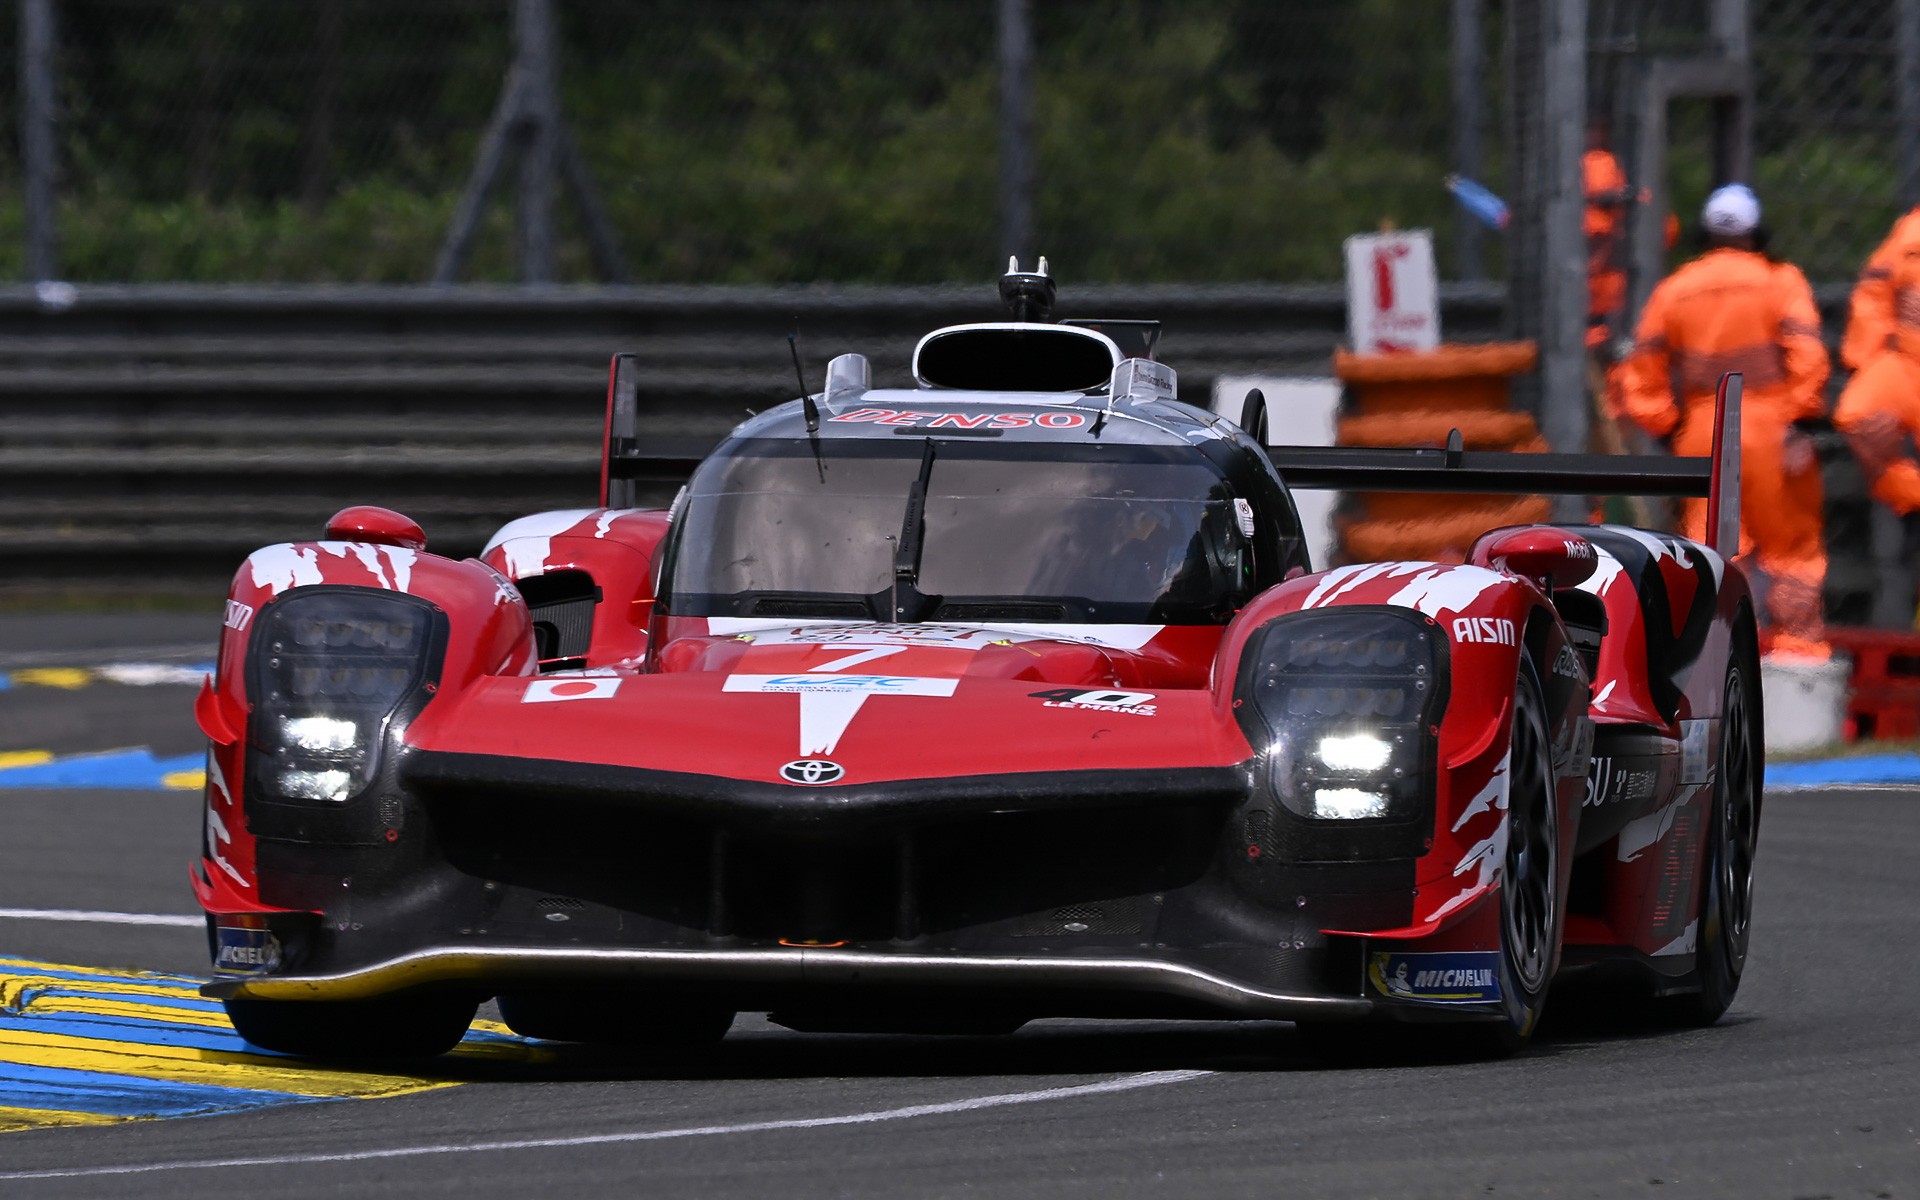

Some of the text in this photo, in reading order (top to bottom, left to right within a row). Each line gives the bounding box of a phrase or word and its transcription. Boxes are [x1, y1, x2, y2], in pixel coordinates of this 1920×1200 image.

[827, 408, 1086, 429] DENSO
[1452, 617, 1516, 647] AISIN
[807, 644, 908, 673] 7
[766, 676, 919, 687] WEC
[1028, 688, 1158, 707] 40
[1042, 701, 1157, 717] LE MANS
[1414, 969, 1493, 988] MICHELIN
